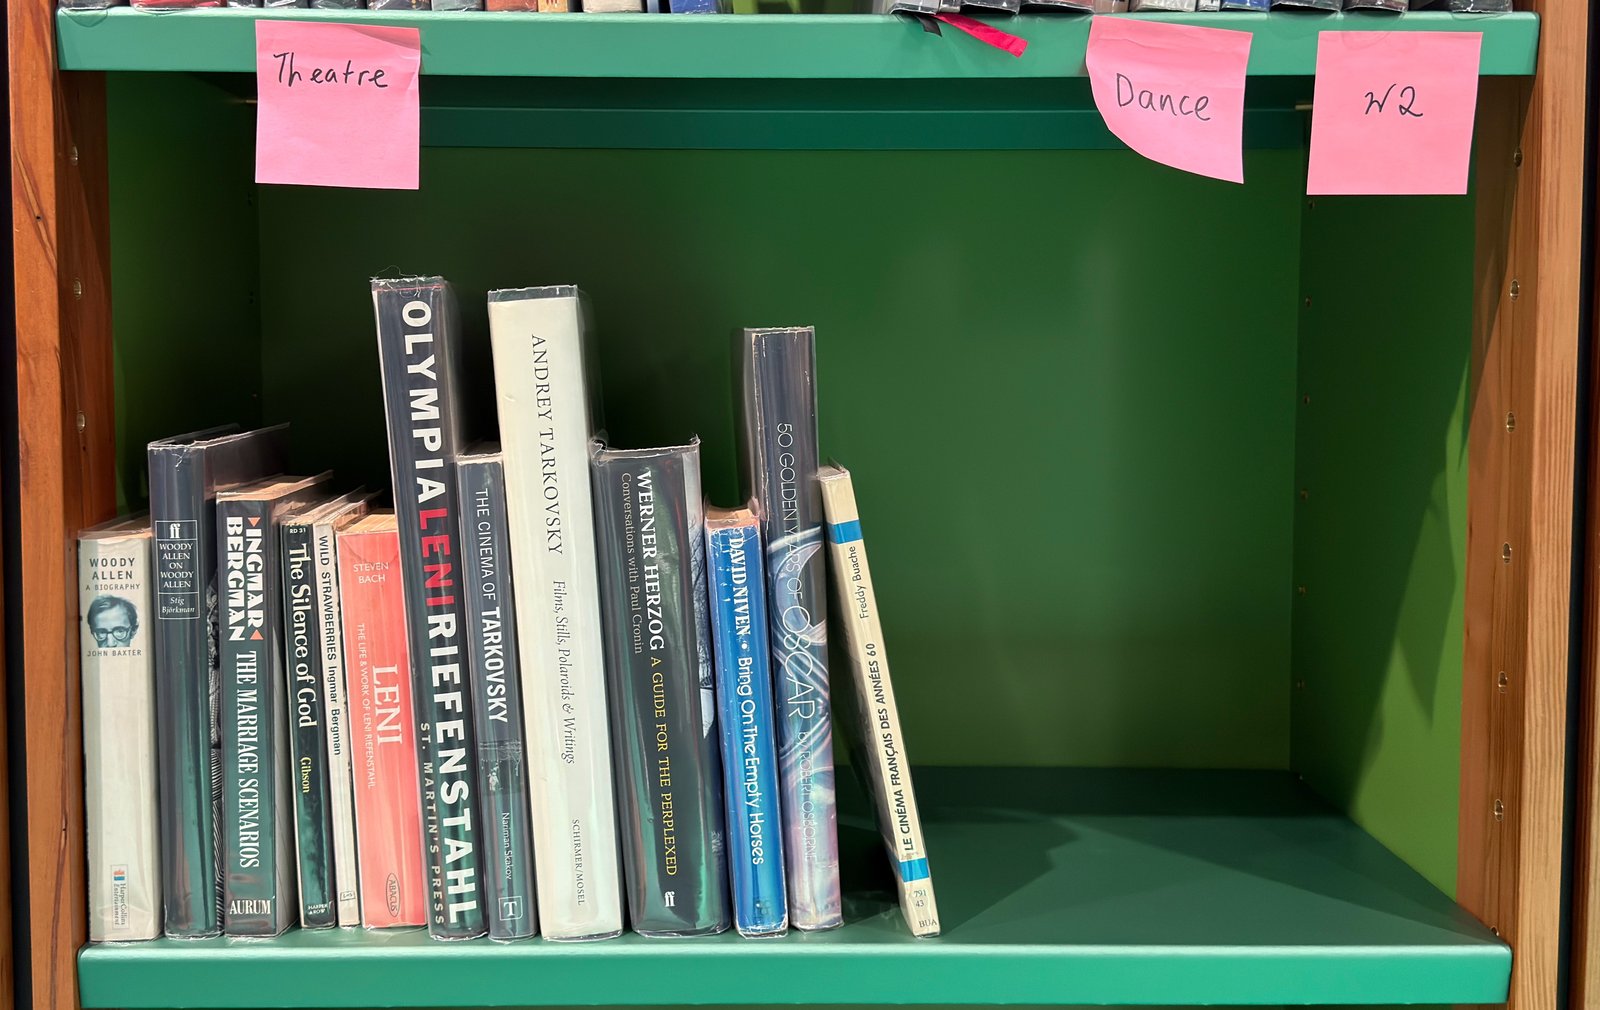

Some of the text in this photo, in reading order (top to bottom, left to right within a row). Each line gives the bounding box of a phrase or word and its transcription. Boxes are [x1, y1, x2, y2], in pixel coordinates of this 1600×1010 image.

[273, 52, 389, 89] Theatre
[1116, 73, 1211, 122] Dance
[532, 334, 563, 556] ANDREY TARKOVSKY
[777, 423, 793, 448] 50
[779, 453, 798, 521] GOLDEN
[159, 543, 193, 551] WOODY
[170, 523, 181, 538] ff
[784, 525, 801, 573] YEARS
[90, 558, 135, 567] WOODY
[92, 571, 133, 580] ALLEN
[160, 571, 194, 579] WOODY
[162, 552, 190, 560] ALLEN
[353, 561, 389, 573] STEVEN
[621, 472, 643, 654] Conversations with Paul Cronin
[226, 517, 245, 641] BERGMAN
[245, 529, 264, 628] INGMAR
[359, 574, 386, 584] BACH
[787, 577, 803, 600] OF
[848, 546, 869, 619] Freddy Buache
[162, 606, 195, 615] Björkman
[170, 597, 185, 605] Stig
[475, 488, 508, 723] THE CINEMA OF TARKOVSKY
[289, 543, 318, 728] The Silence of God
[319, 536, 341, 756] WILD STRAWBERRIES Ingmar Bergman
[357, 624, 365, 641] THE
[359, 642, 367, 659] LIFE
[360, 667, 370, 695] WORK
[552, 580, 577, 765] Films, Stills, Polaroids & Writings
[637, 471, 677, 876] WERNER HERZOG A GUIDE FOR THE PERPLEXED
[782, 605, 815, 719] OSCAR
[363, 697, 371, 711] OF
[372, 664, 402, 745] LENI
[729, 537, 765, 865] DAVID NIVEN Bring On The Empty Horses
[363, 712, 372, 733] LENI
[236, 650, 260, 868] THE MARRIAGE SCENARIOS
[365, 734, 377, 789] RIEFENSTAHL
[866, 643, 914, 851] LE CINÉMA FRANÇAIS DES ANNÉES 60
[300, 756, 312, 793] Gibson
[799, 750, 813, 796] ROBERT
[420, 723, 445, 925] ST. MARTIN'S PRESS
[802, 801, 817, 862] OSBORNE
[502, 812, 512, 880] Nariman Skakov
[572, 819, 586, 906] SCHIRMER/MOSEL
[229, 900, 271, 915] AURUM
[389, 878, 398, 912] ABACUS
[503, 901, 517, 917] T
[665, 891, 675, 907] ff
[919, 919, 938, 927] BUA
